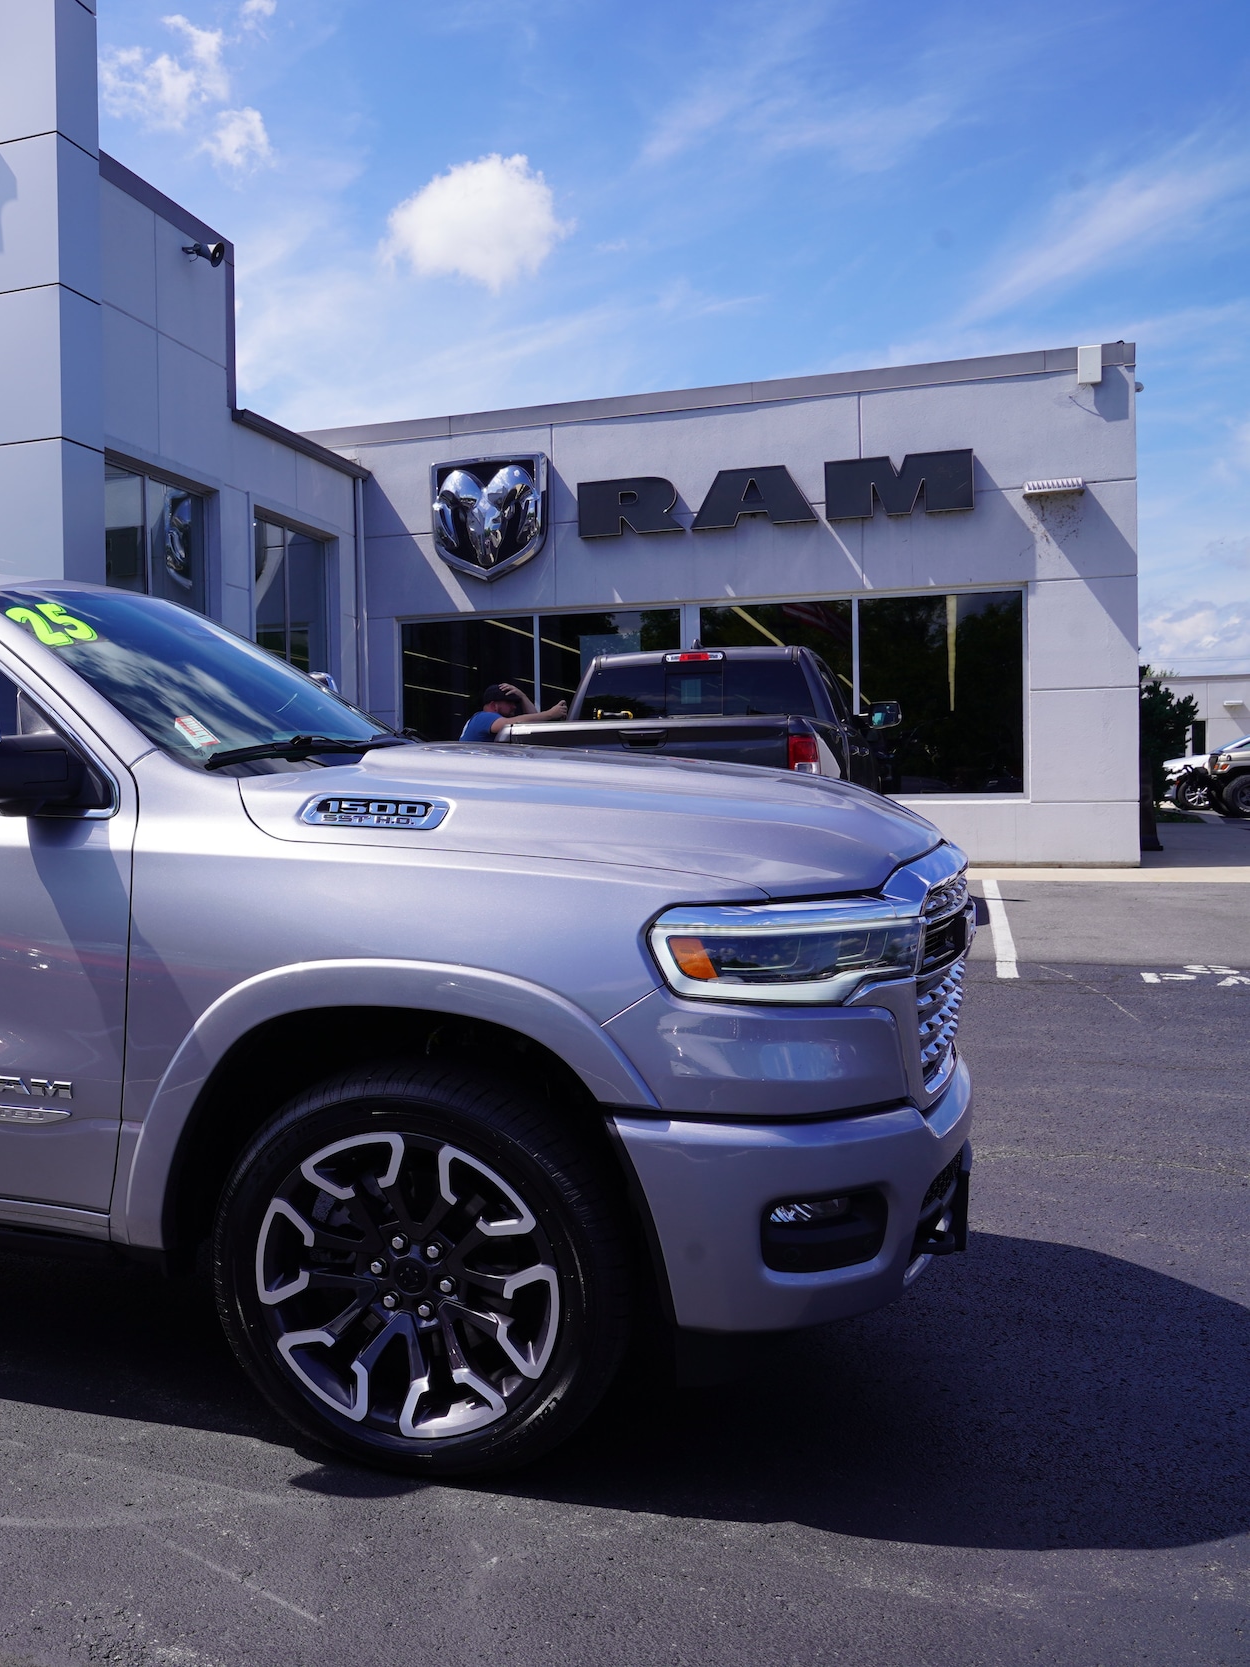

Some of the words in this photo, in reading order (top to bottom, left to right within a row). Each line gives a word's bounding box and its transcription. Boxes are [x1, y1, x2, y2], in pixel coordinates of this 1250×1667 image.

[577, 448, 975, 540] RAM
[5, 603, 98, 647] 25
[322, 813, 370, 824] SST
[325, 799, 427, 816] 1500
